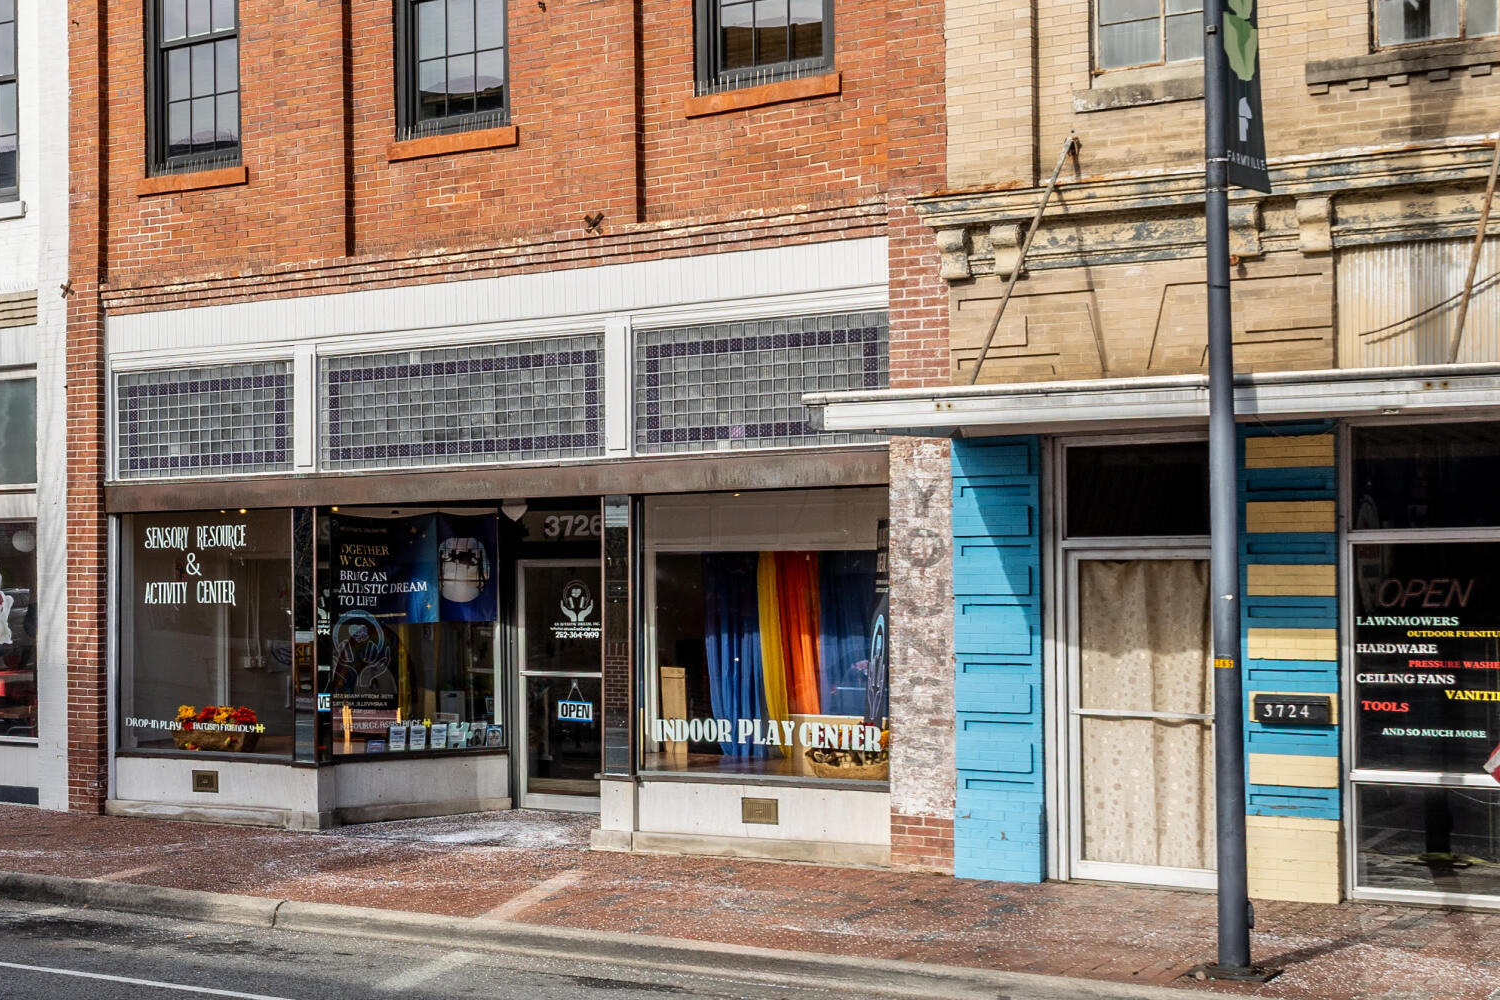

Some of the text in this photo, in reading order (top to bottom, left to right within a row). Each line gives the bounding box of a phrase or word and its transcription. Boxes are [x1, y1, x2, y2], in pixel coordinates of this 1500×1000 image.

[1227, 150, 1266, 171] FARMVILLE
[544, 514, 602, 537] 3726
[144, 524, 247, 551] SENSORY RESOURCE
[341, 543, 389, 556] OGETHER
[186, 552, 202, 576] &
[354, 556, 376, 567] CAN
[371, 571, 388, 582] AN
[144, 580, 236, 606] ACTIVITY CENTER
[390, 581, 428, 594] DREAM
[1379, 579, 1474, 608] OPEN
[338, 595, 355, 606] TO
[1356, 616, 1460, 626] LAWNMOWERS
[555, 631, 599, 639] 252-364-9199
[1356, 643, 1438, 654] HARDWARE
[1408, 660, 1461, 668] PRESSURE
[1356, 673, 1456, 685] CEILING FANS
[561, 702, 590, 719] OPEN
[1263, 704, 1310, 718] 3724
[1361, 700, 1410, 713] TOOLS
[125, 717, 255, 733] DROP-IN PLAY AUTISM FRIENDLY
[655, 718, 882, 752] INDOOR PLAY CENTER
[1382, 728, 1487, 738] AND SO MUCH MORE
